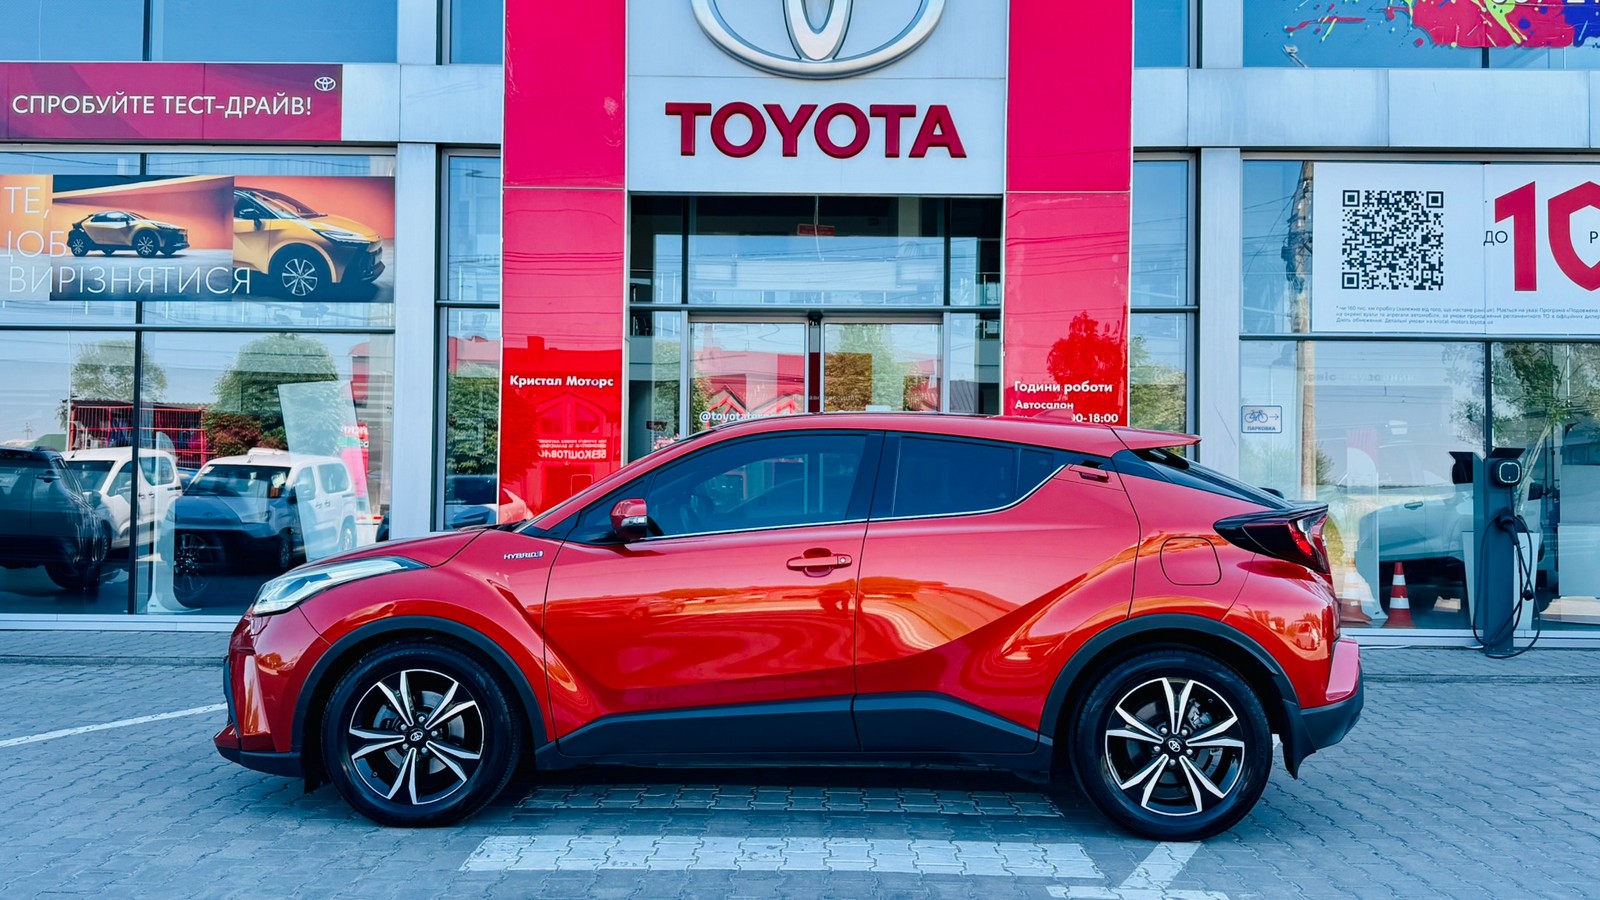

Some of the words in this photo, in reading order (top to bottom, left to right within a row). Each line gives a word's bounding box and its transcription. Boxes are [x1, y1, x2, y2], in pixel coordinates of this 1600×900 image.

[12, 91, 155, 115] СПРОБУЙТЕ
[161, 92, 312, 118] ТЕСТ-ДРАЙВ!
[665, 101, 968, 159] TOYOTA
[4, 186, 50, 219] ТЕ,
[1483, 230, 1508, 246] ДО
[9, 266, 251, 294] ВИРІЗНЯТИСЯ
[510, 375, 562, 388] Кристал
[566, 376, 614, 388] Моторс
[1014, 380, 1061, 394] Години
[1064, 380, 1113, 395] роботи
[1015, 400, 1074, 410] Автосалон
